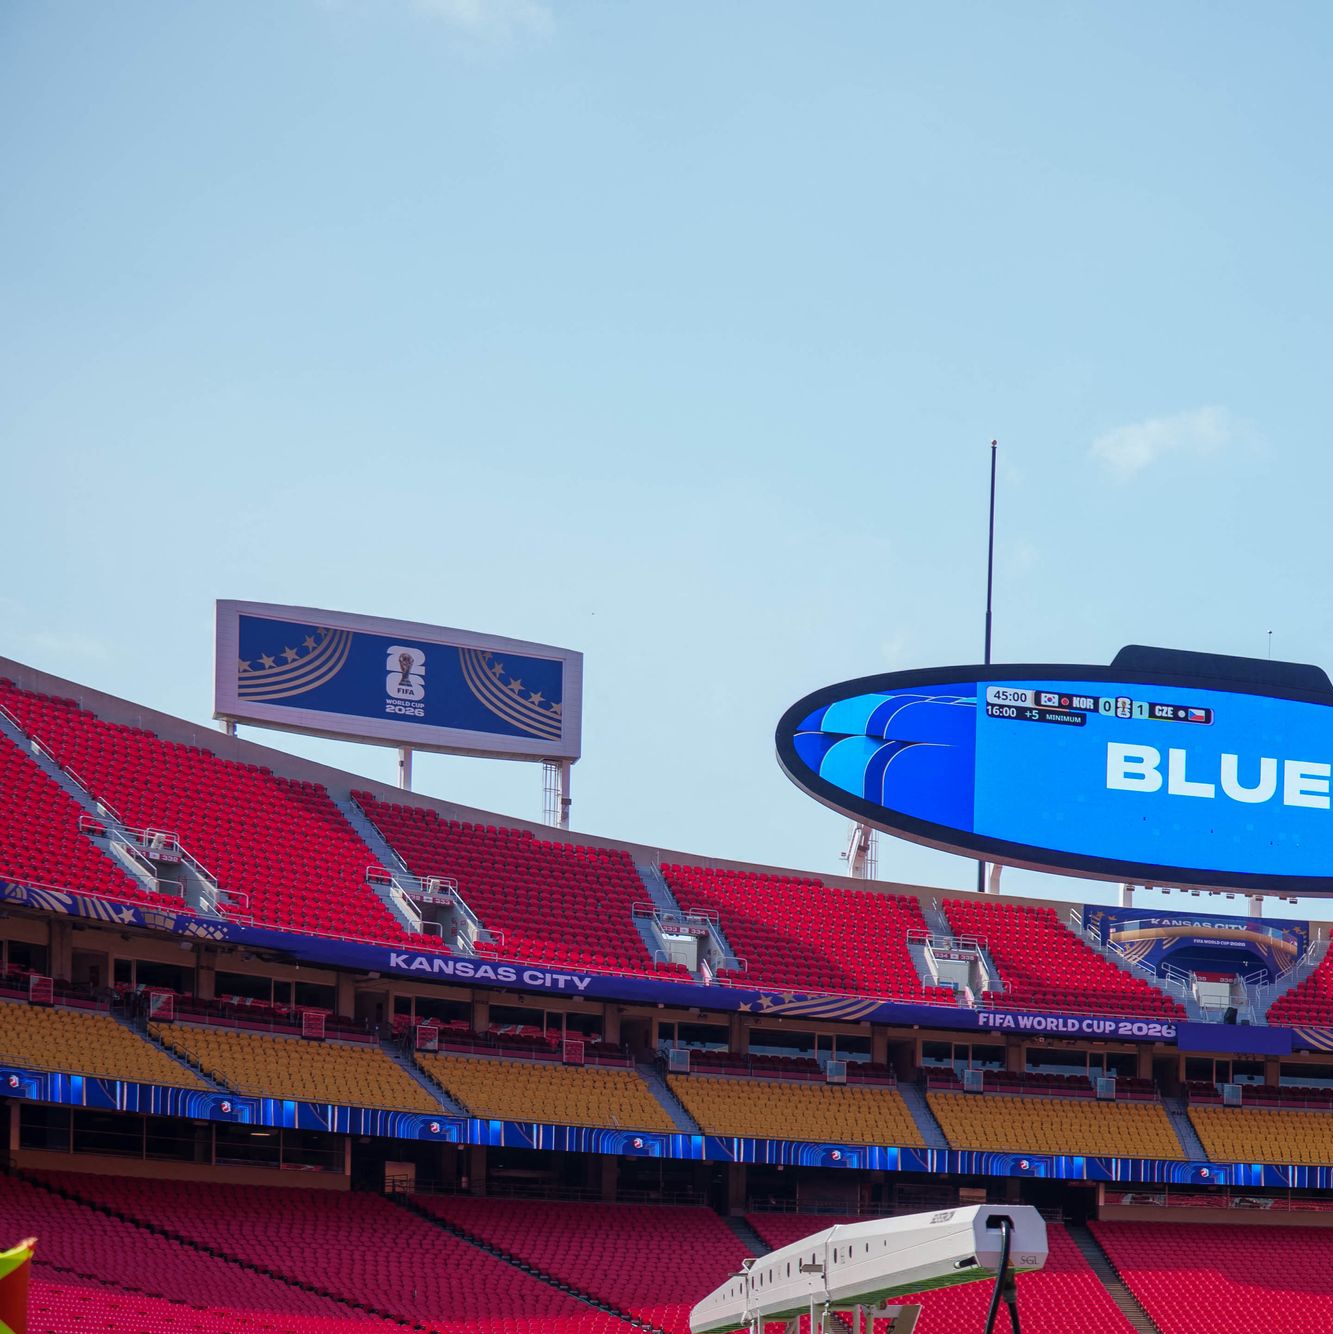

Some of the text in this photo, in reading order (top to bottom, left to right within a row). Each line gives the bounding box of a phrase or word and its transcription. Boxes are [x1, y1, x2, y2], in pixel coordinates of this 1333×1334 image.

[397, 687, 415, 696] FIFA
[385, 704, 425, 717] 2026
[386, 698, 411, 708] WORLD
[993, 690, 1174, 718] 45:00 KOR 0 1 CZE
[986, 705, 1081, 723] 16:00 +5 MINIMUM
[1107, 742, 1332, 810] BLUE
[1151, 917, 1248, 931] KANSAS CITY
[389, 952, 592, 991] KANSAS CITY
[978, 1012, 1177, 1038] FIFA WORLD CUP 2026
[1020, 1255, 1040, 1265] SGL
